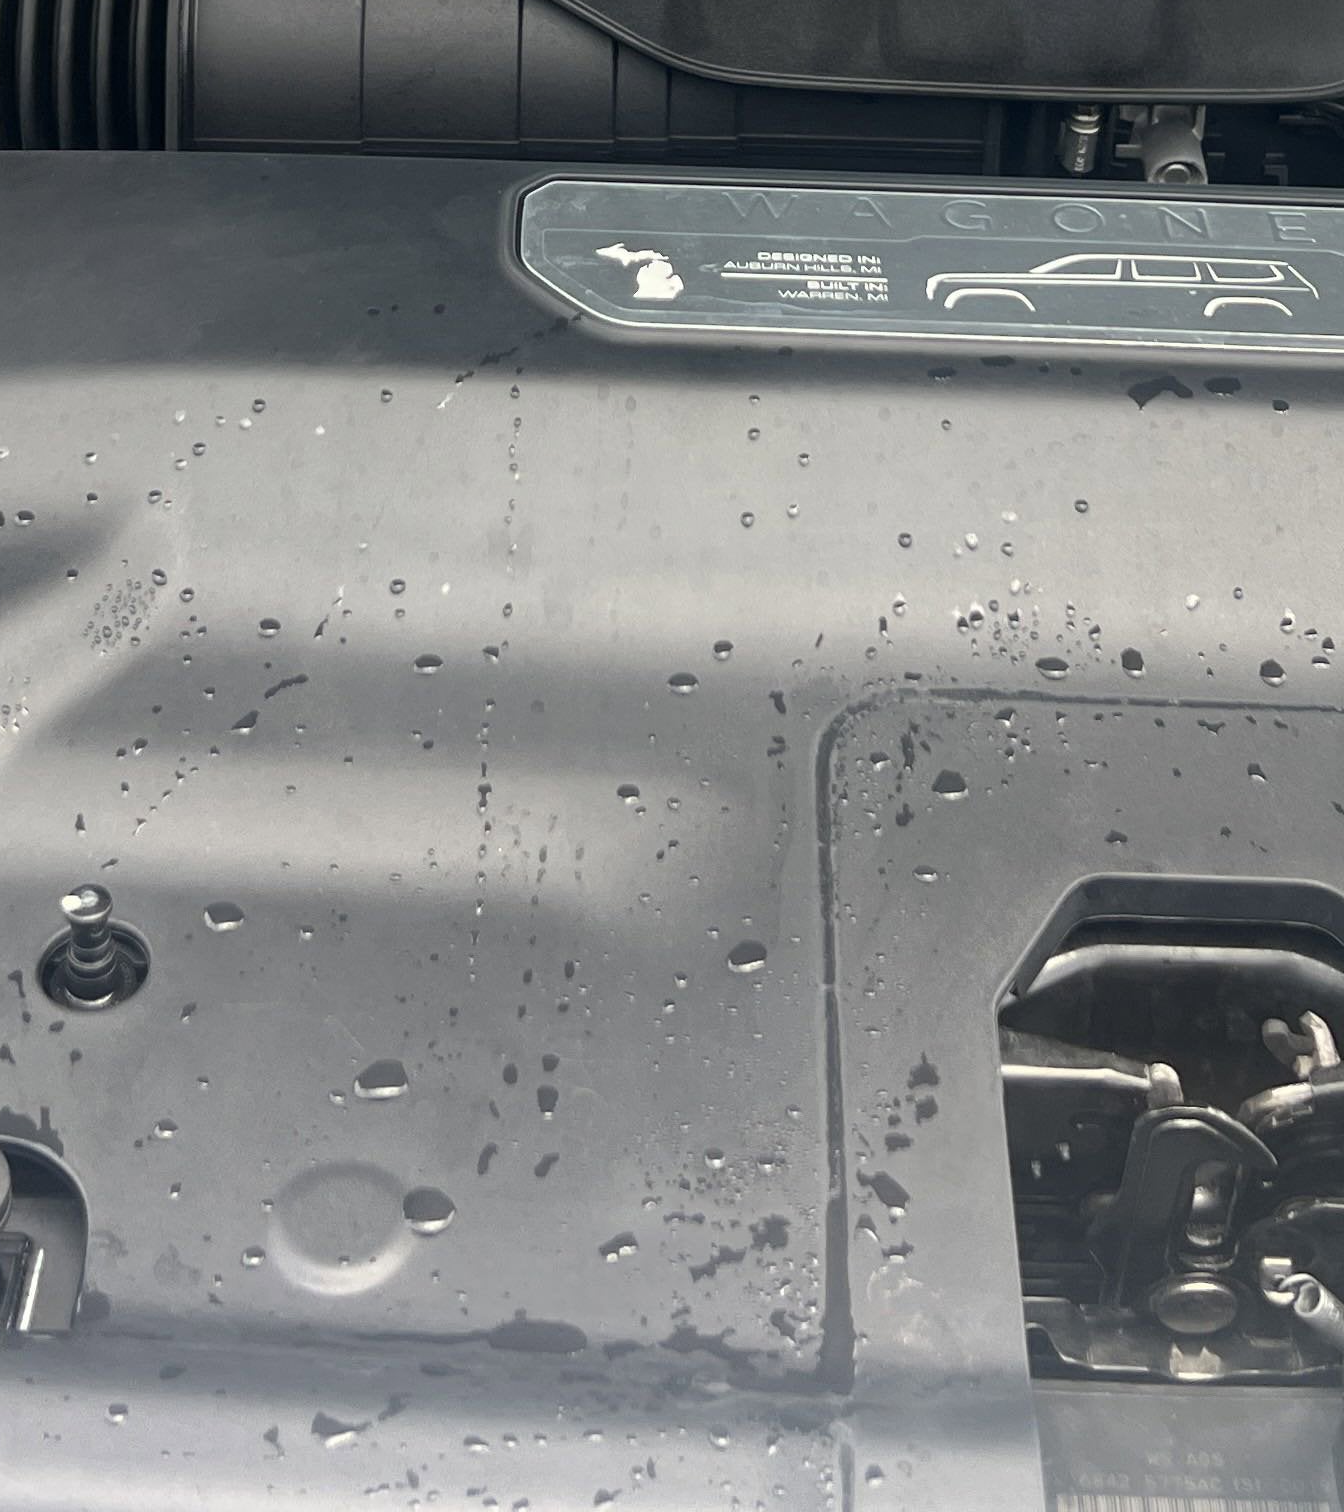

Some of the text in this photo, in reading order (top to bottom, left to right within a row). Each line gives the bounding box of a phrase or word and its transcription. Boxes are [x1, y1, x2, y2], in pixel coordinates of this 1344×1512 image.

[757, 251, 882, 266] DESIGNED IN:
[723, 260, 883, 275] AUBURN HILLS, MI
[807, 280, 889, 293] BUILT IN:
[777, 289, 889, 303] WARREN, MI
